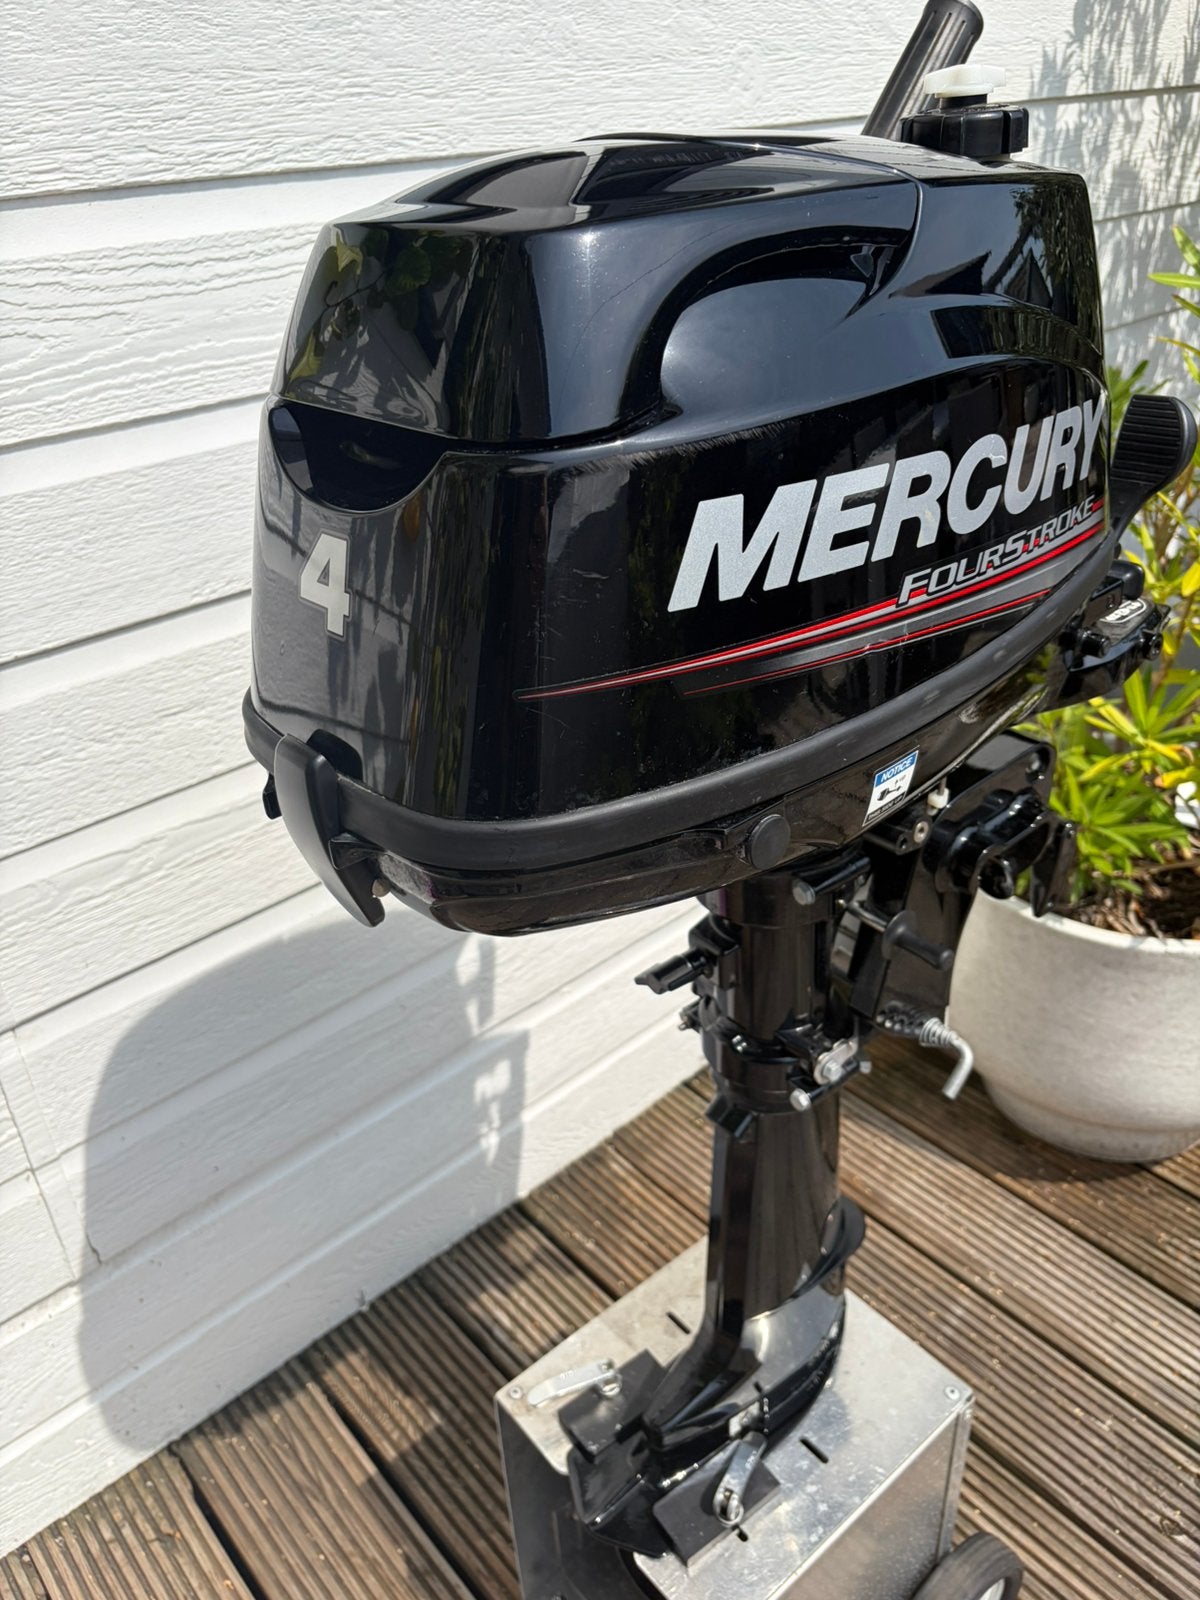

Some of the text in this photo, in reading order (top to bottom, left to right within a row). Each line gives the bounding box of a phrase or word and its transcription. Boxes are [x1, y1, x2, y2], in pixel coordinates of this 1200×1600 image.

[668, 391, 1105, 612] MERCURY
[897, 494, 1095, 606] FOURSTROKE
[300, 533, 350, 636] 4
[880, 756, 914, 783] NOTICE
